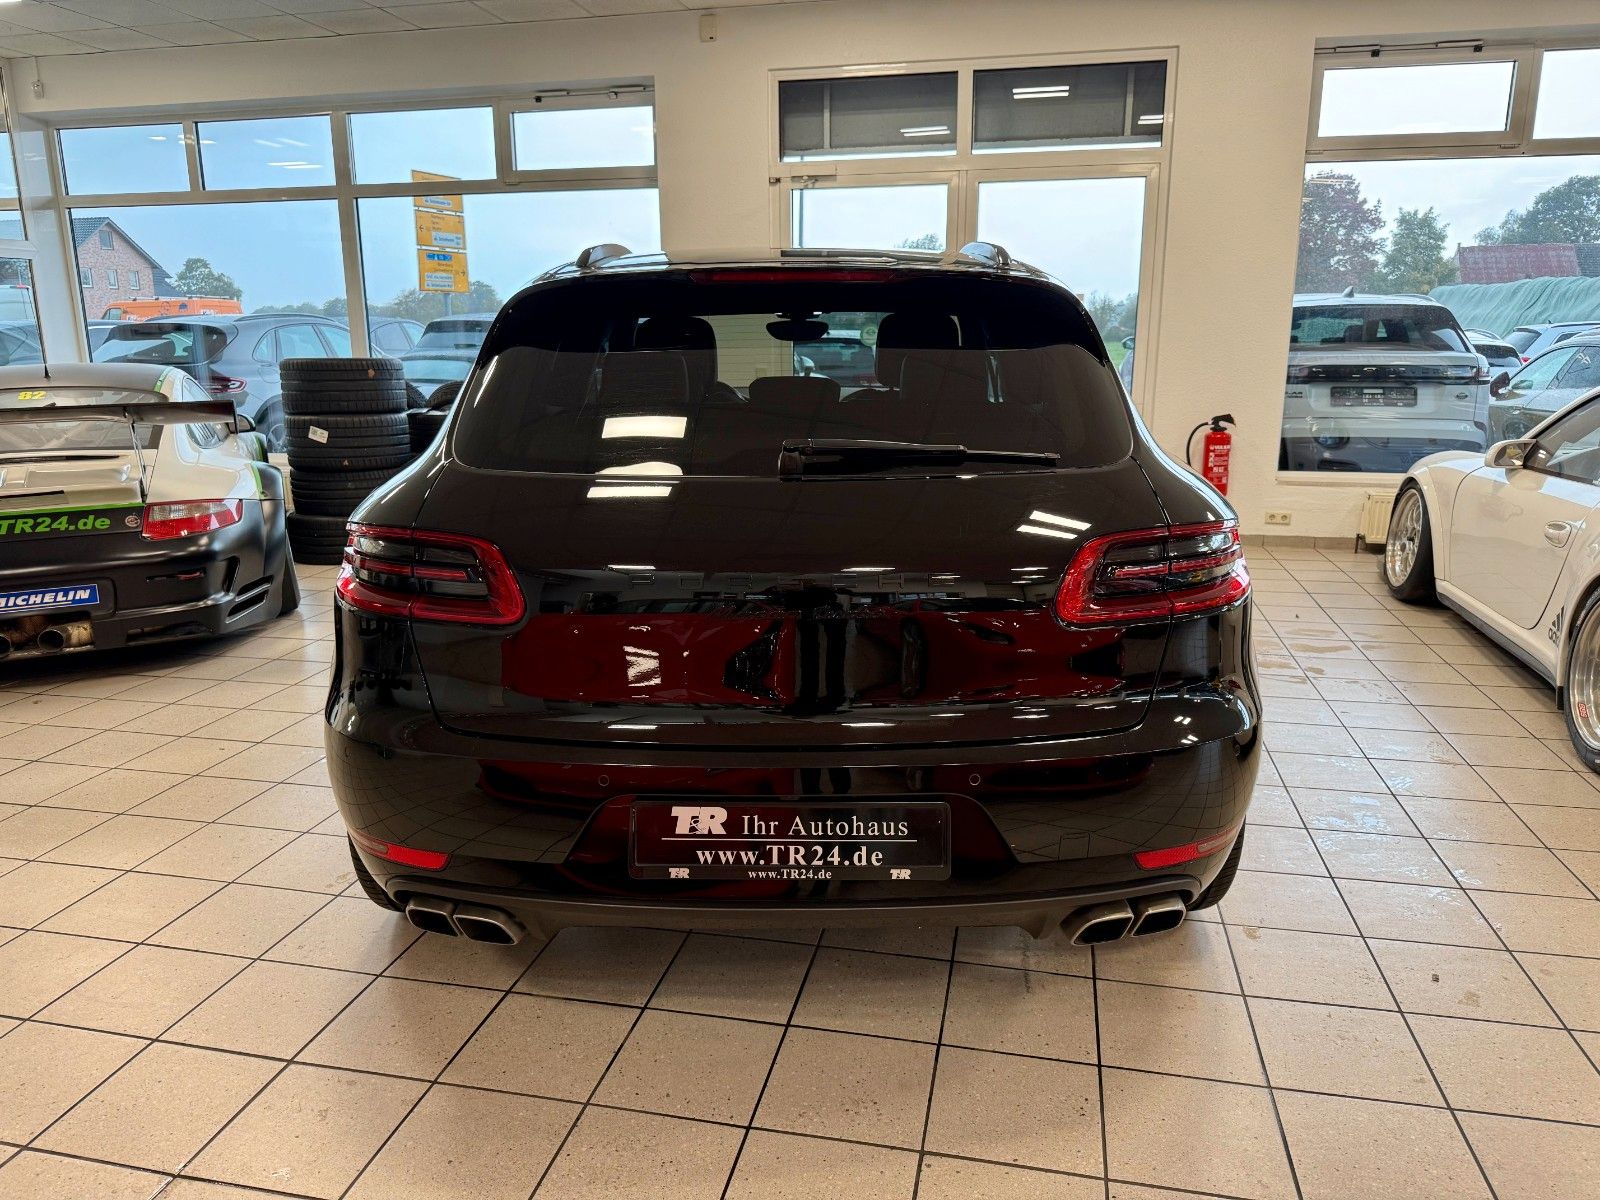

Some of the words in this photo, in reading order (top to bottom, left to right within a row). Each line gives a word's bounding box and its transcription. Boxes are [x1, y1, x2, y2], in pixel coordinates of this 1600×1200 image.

[18, 390, 48, 400] 82
[0, 515, 111, 535] TR24.de
[671, 806, 728, 834] T&R
[742, 815, 778, 835] Ihr
[787, 815, 909, 836] Autohaus
[696, 845, 883, 867] www.TR24.de
[748, 868, 832, 879] www.TR24.de
